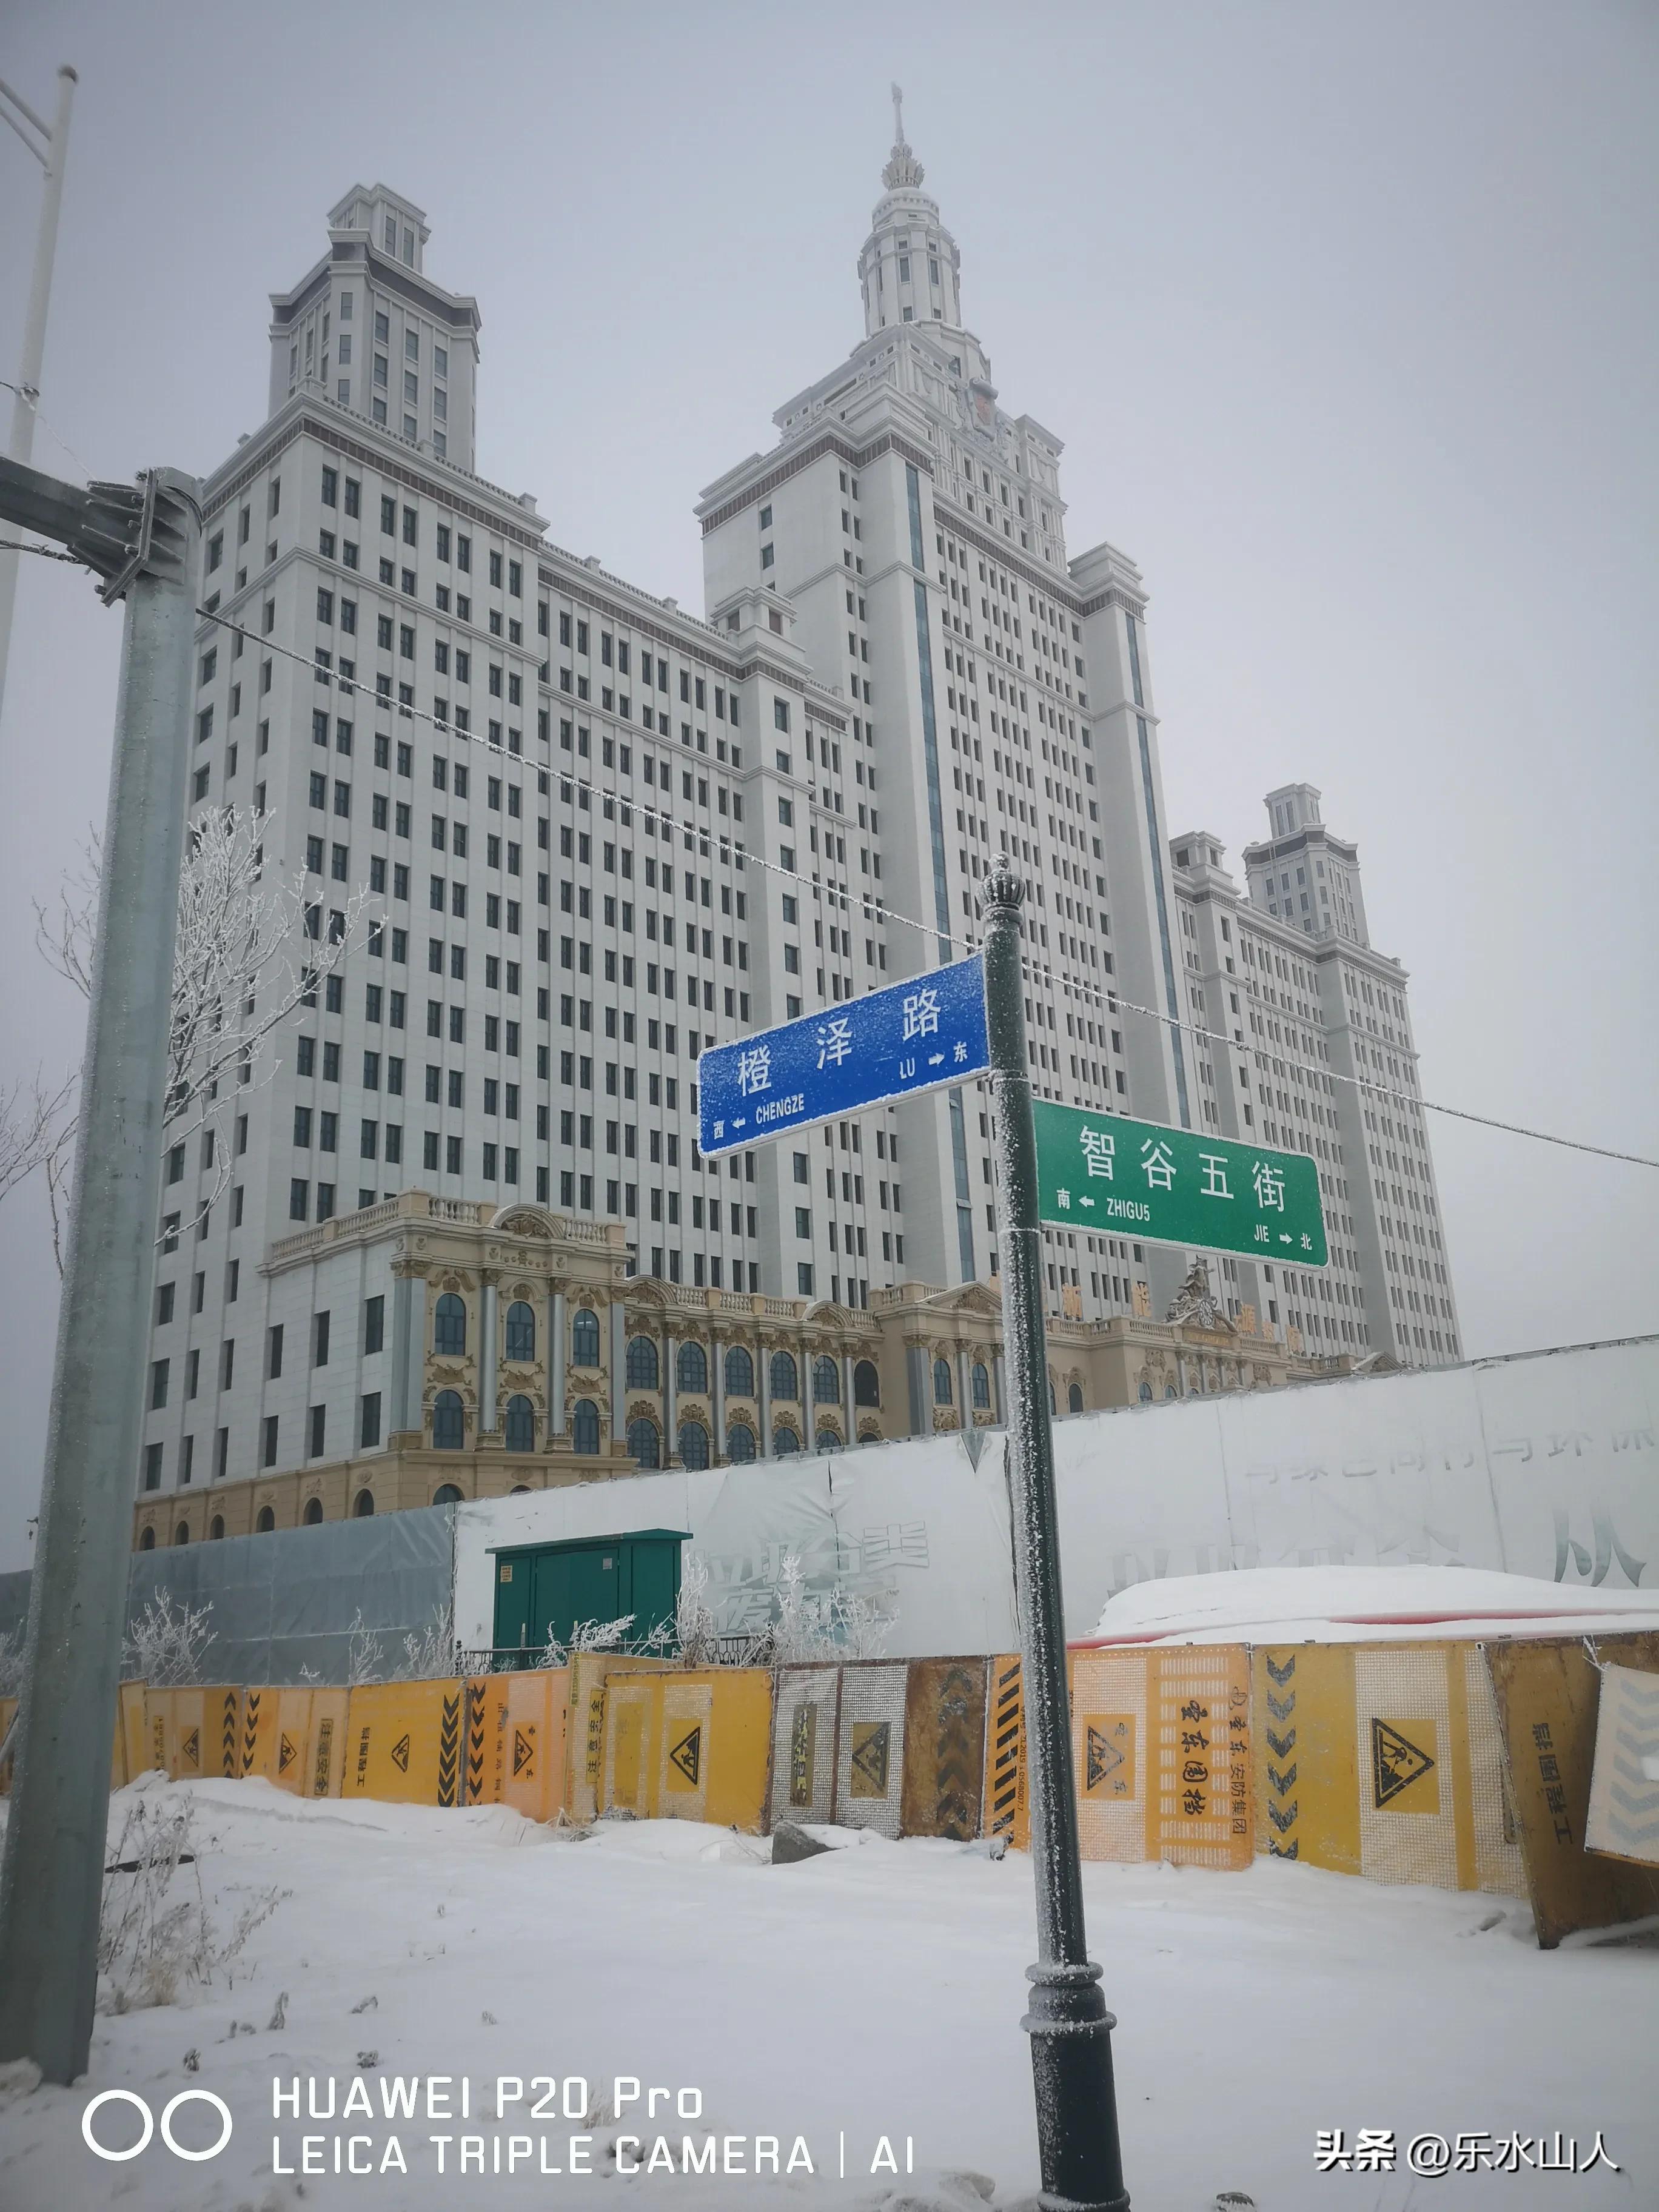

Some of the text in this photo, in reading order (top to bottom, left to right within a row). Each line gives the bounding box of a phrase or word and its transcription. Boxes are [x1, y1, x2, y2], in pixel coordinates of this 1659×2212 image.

[738, 988, 941, 1097] 橙泽路
[712, 1041, 968, 1141] 西 CHENGZE LU 东
[1079, 1125, 1286, 1212] 智谷五街
[1056, 1187, 1313, 1251] 南 ZHIGU5 JIE 北
